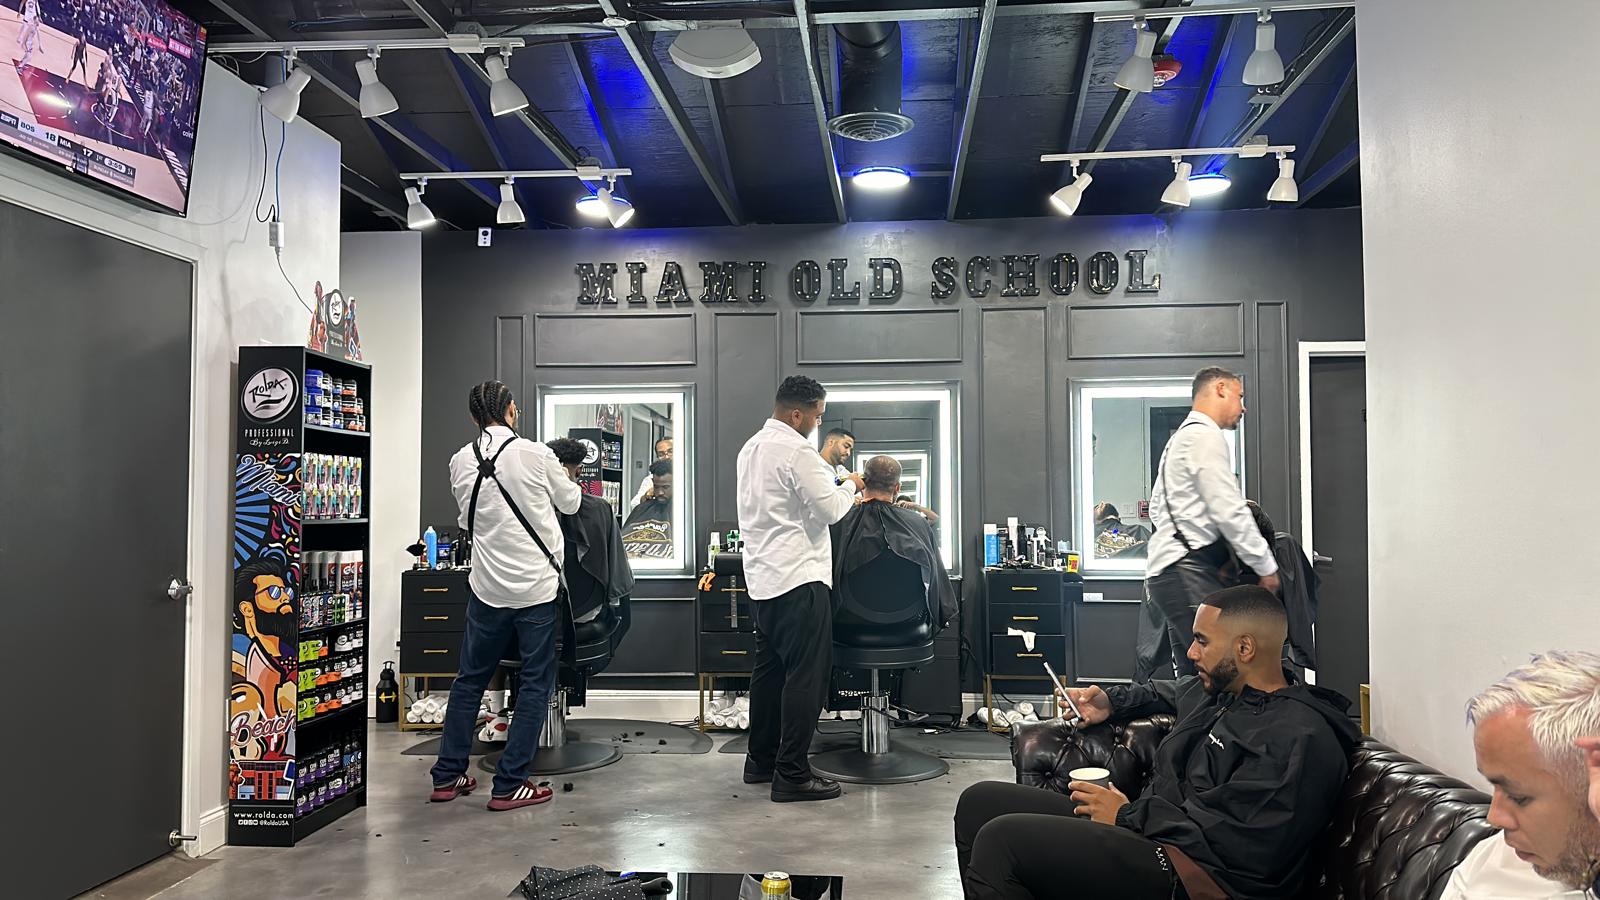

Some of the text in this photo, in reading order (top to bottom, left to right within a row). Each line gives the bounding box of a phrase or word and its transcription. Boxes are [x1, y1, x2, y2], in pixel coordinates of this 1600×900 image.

[20, 121, 36, 133] BOS
[45, 131, 56, 142] 18
[59, 138, 72, 149] MIA
[82, 148, 93, 157] 17
[575, 250, 1161, 304] MIAMI OLD SCHOOL
[244, 428, 294, 438] PROFESSIONAL
[249, 438, 262, 447] By
[235, 454, 301, 506] Miami
[229, 709, 296, 747] Beach
[233, 810, 295, 819] www.rolda.com
